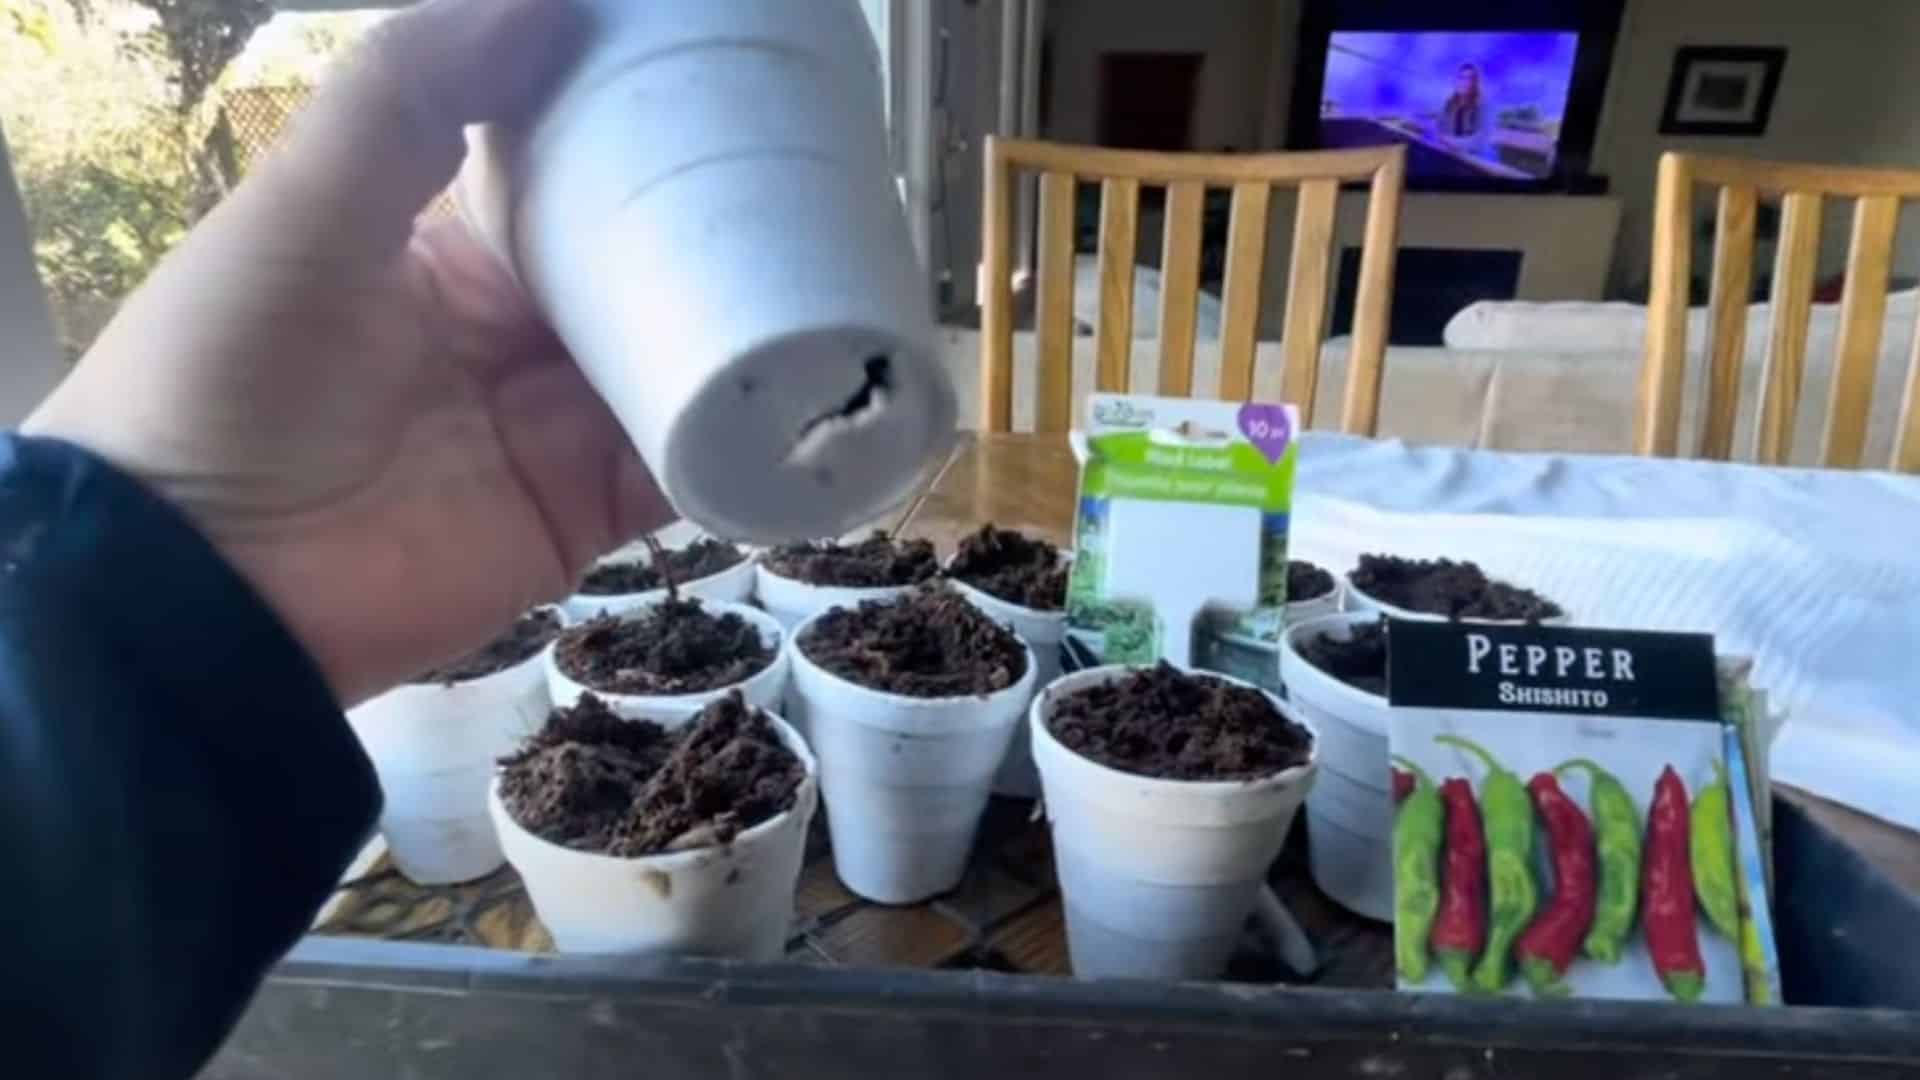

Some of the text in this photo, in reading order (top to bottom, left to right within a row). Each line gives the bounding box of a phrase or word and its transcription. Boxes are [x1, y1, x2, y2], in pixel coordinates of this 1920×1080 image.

[1248, 419, 1269, 438] 10
[1465, 633, 1636, 681] PEPPER
[1498, 681, 1608, 709] SHISHITO
